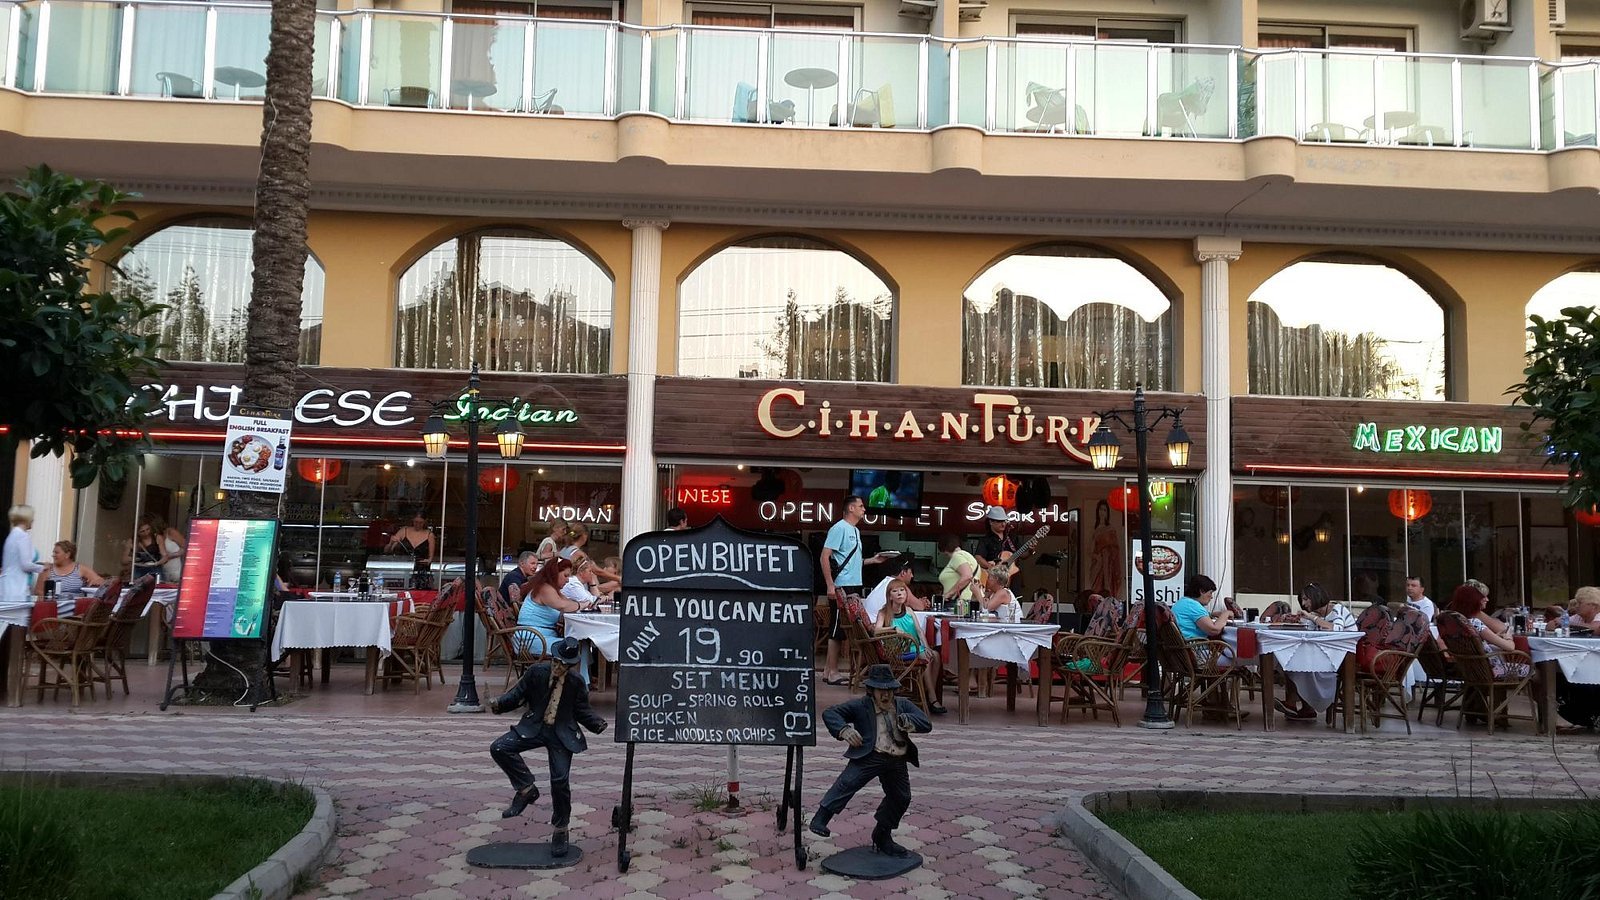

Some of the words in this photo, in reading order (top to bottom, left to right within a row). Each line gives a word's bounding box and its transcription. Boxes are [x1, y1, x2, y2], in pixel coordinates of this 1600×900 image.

[256, 427, 290, 435] BREAKFAST
[1354, 423, 1503, 454] MEXICAN
[539, 506, 612, 523] INDIAN
[760, 501, 833, 521] OPEN
[636, 544, 707, 573] OPEN
[712, 542, 799, 573] BUFFET
[1136, 586, 1181, 602] sshi
[625, 595, 666, 617] ALL
[674, 598, 714, 620] YOU
[718, 601, 764, 623] CAN
[770, 603, 809, 624] EAT
[626, 621, 661, 661] ONLY
[671, 671, 712, 690] SET
[721, 672, 780, 690] MENU
[743, 695, 785, 707] ROLLS
[628, 711, 697, 726] CHICKEN
[726, 728, 741, 742] OR
[742, 727, 776, 743] CHIPS
